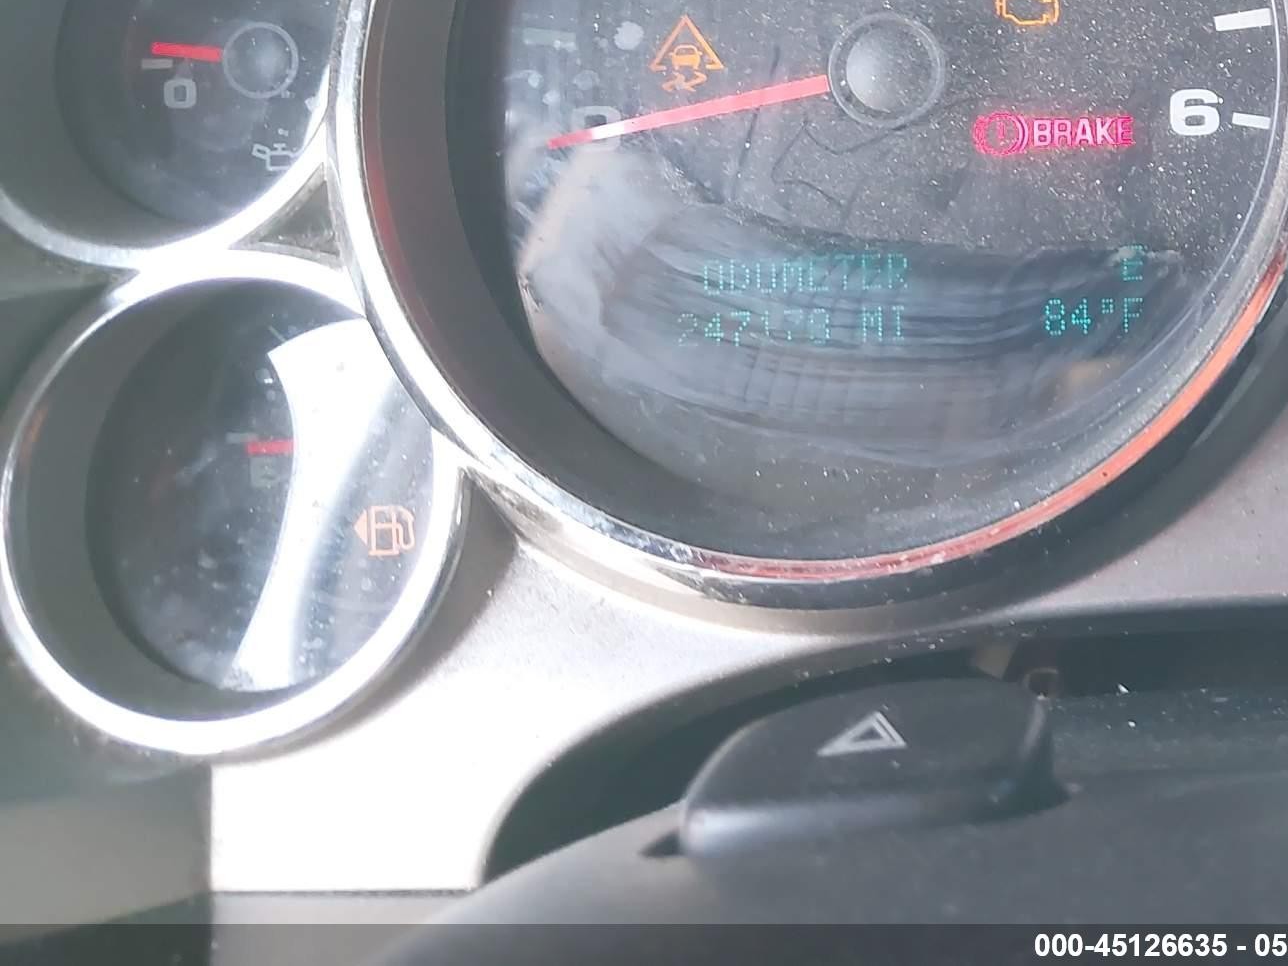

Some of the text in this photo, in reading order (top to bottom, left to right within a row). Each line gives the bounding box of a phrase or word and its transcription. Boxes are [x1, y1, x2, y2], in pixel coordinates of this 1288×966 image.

[163, 77, 198, 109] 0
[1170, 88, 1220, 135] 6
[571, 105, 621, 151] 0
[1032, 117, 1134, 146] BRAKE
[862, 305, 906, 344] MI
[1044, 297, 1144, 335] 84°F
